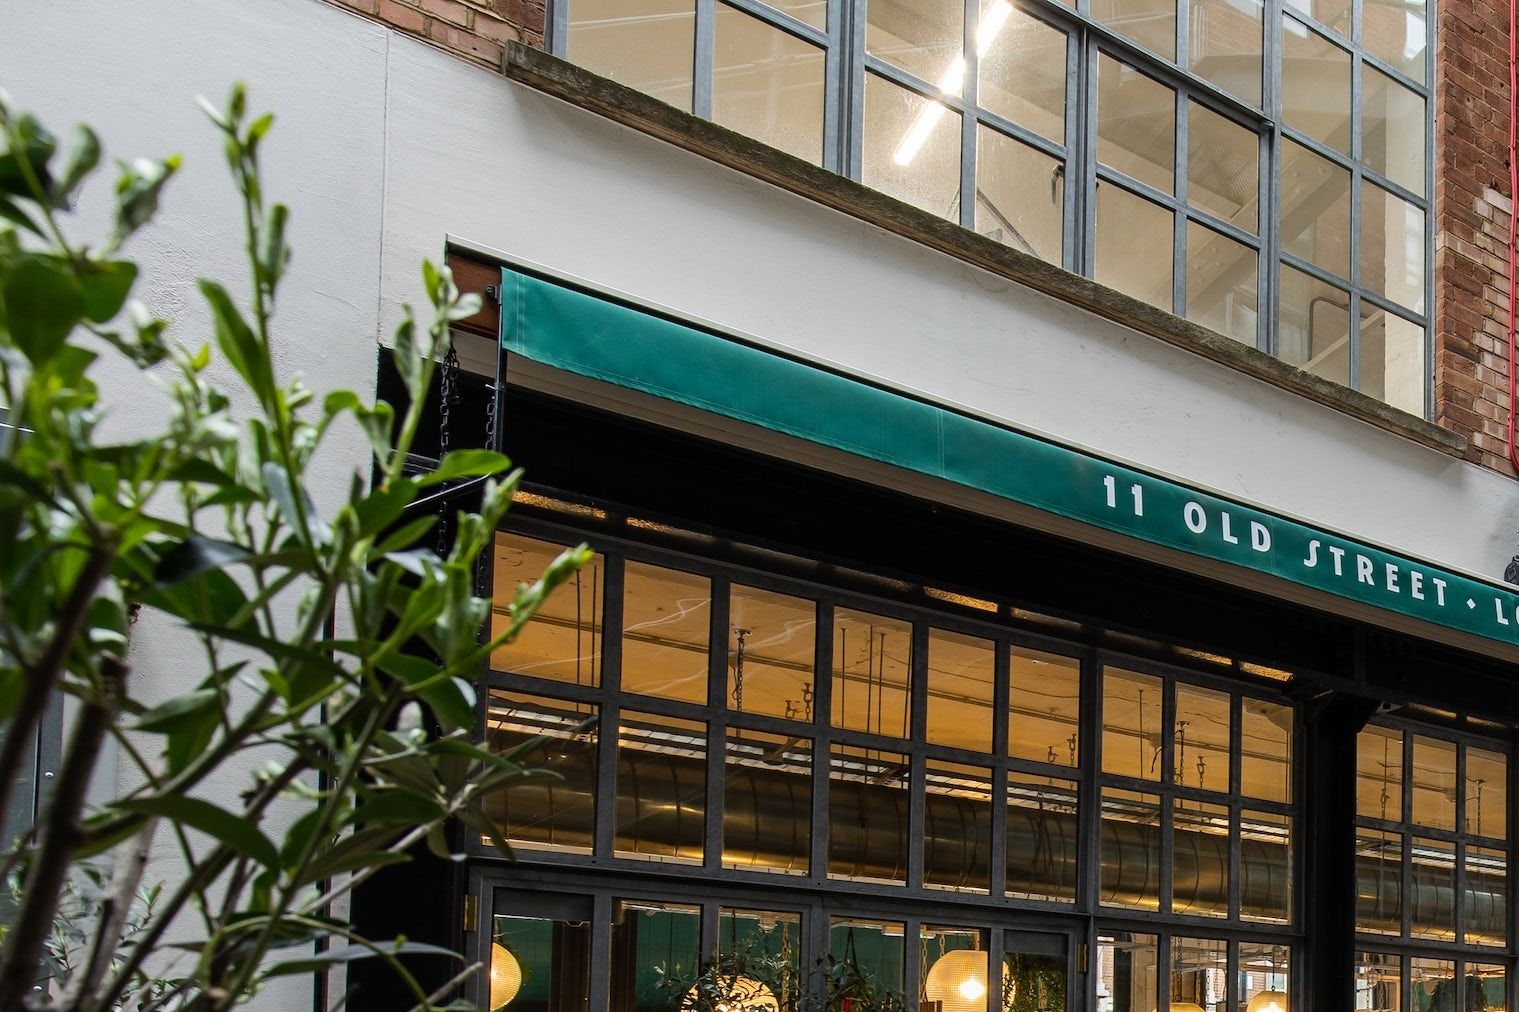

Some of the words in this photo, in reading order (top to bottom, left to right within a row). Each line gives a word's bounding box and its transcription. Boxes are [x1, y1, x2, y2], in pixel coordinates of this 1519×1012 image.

[1103, 475, 1143, 517] 11
[1183, 501, 1272, 553] OLD
[1303, 539, 1448, 607] STREET
